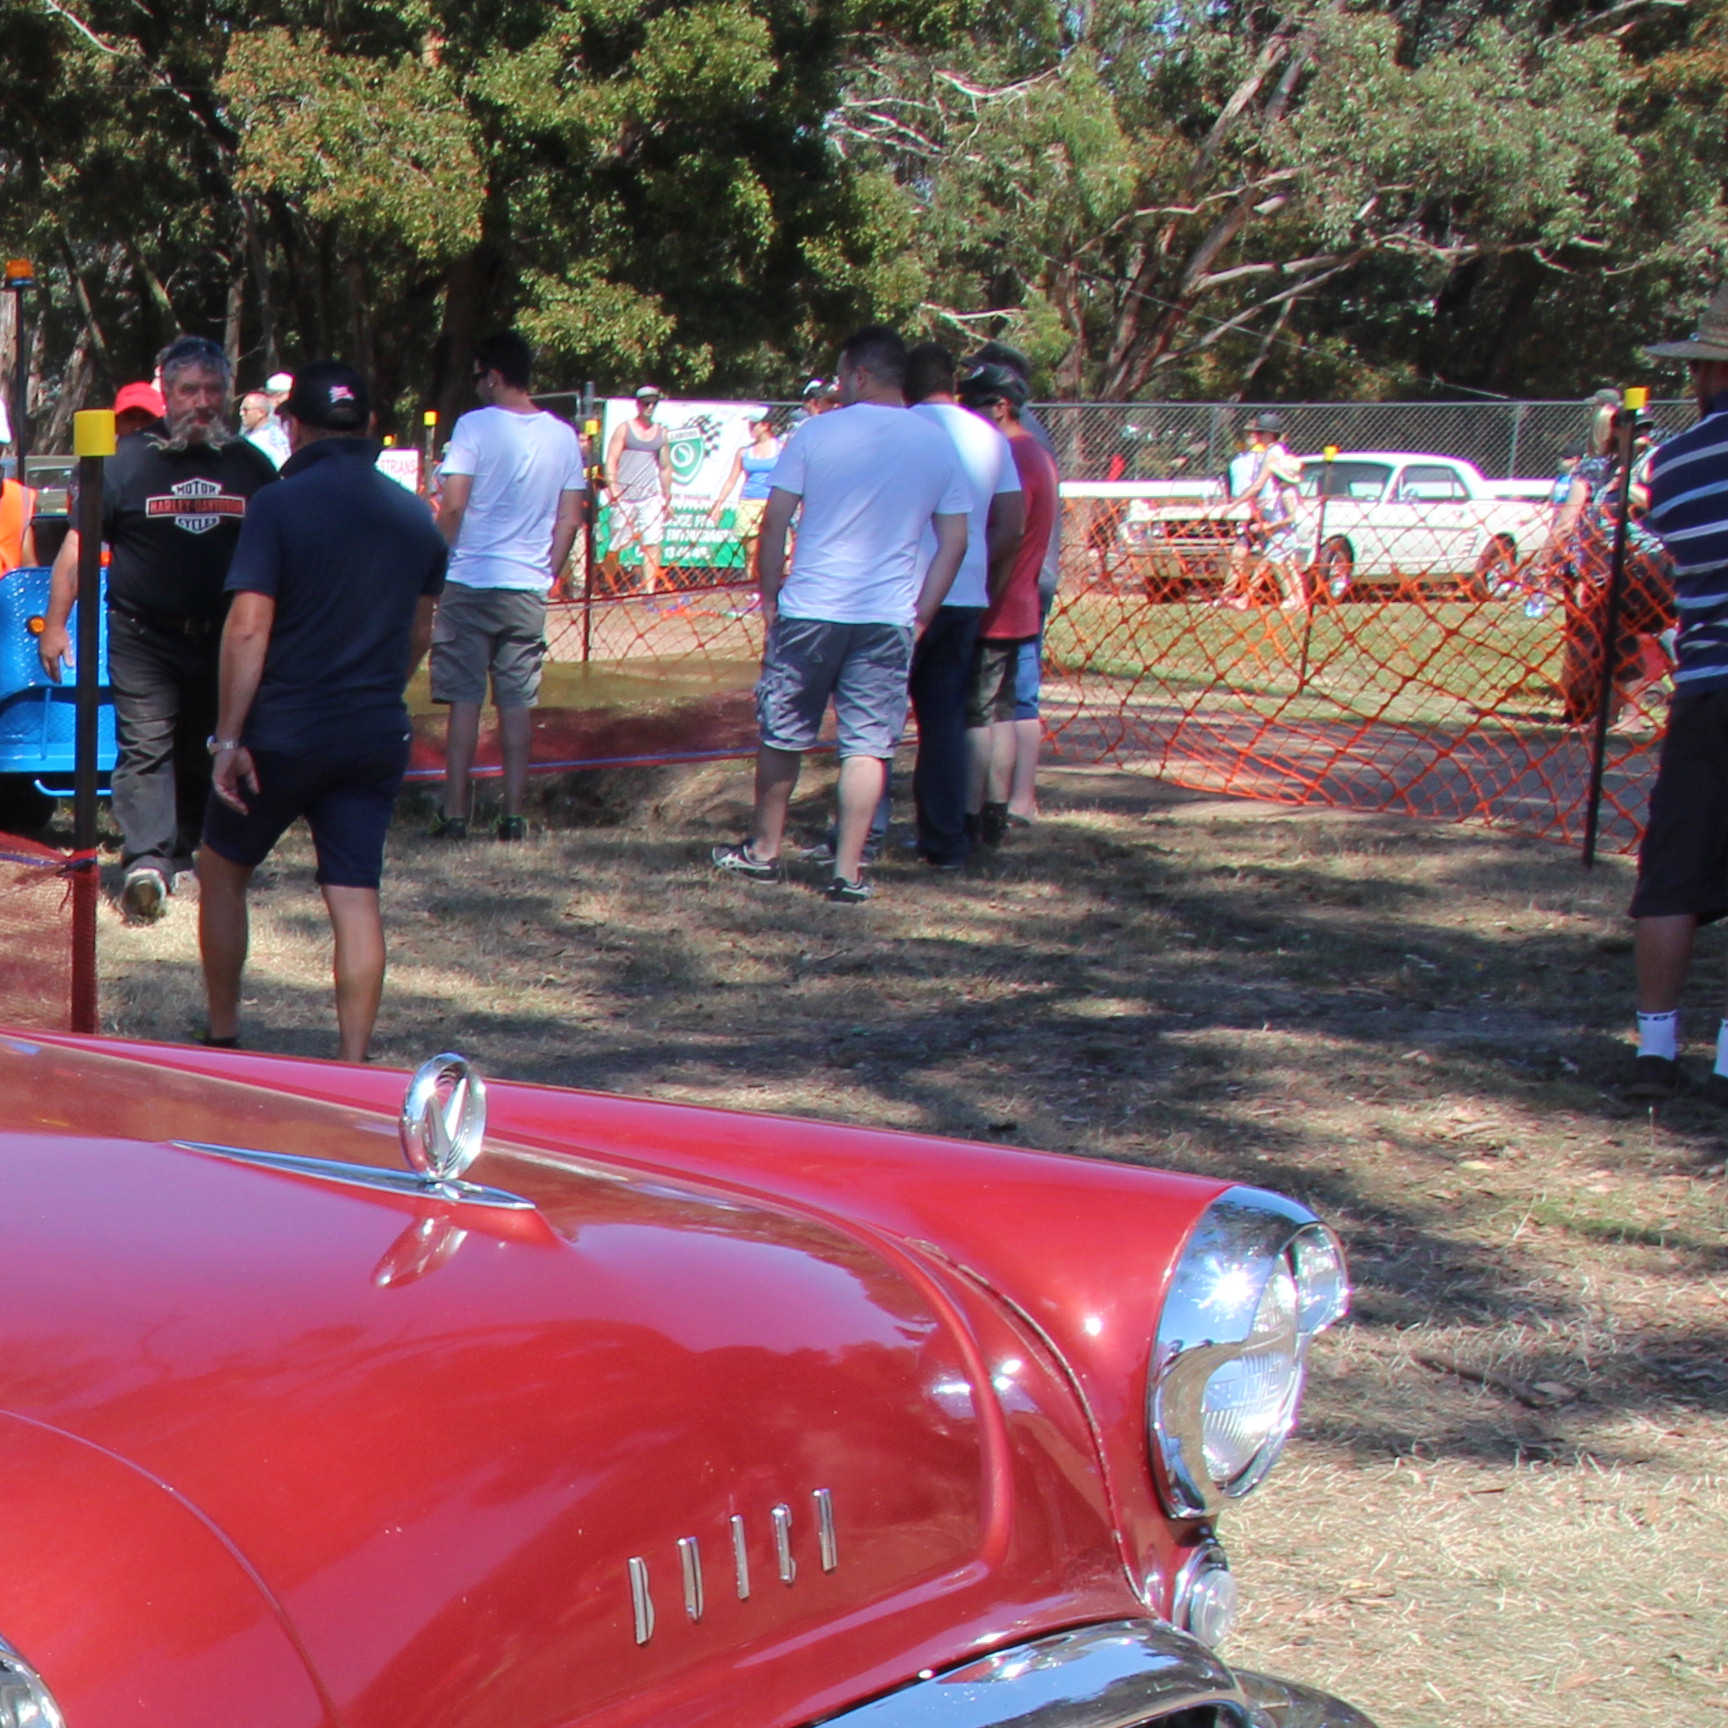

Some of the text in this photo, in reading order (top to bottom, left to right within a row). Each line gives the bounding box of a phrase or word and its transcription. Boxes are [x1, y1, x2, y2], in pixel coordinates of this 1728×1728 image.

[378, 459, 417, 474] STRIANS
[176, 480, 217, 494] MOTOR
[150, 499, 243, 515] HARLEY-DAVI
[177, 518, 220, 531] CYCLES
